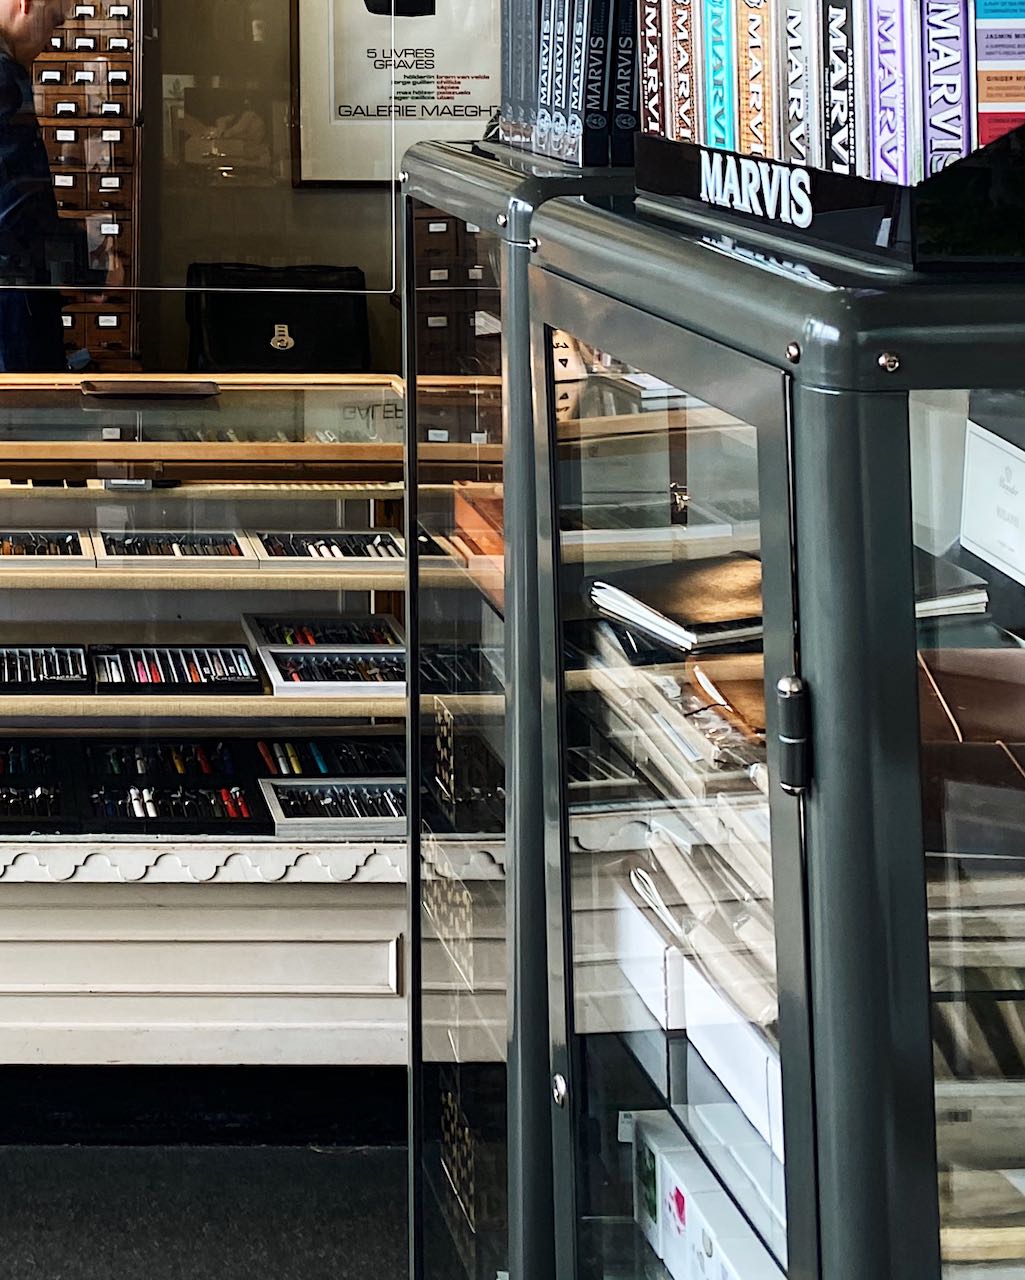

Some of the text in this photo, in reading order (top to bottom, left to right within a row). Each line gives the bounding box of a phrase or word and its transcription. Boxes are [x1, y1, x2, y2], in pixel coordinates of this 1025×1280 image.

[366, 48, 435, 59] 5 LIVRES
[373, 59, 435, 70] GRAVES
[539, 19, 551, 105] MARVIS
[554, 20, 565, 108] MARVIS
[571, 21, 584, 111] MARVIS
[586, 36, 605, 111] MARVIS
[615, 36, 634, 111] MARVIS
[643, 5, 659, 133] MARVI
[673, 9, 692, 142] MARVI
[711, 11, 725, 146] MARVI
[748, 13, 765, 156] MARVI
[787, 8, 806, 165] MARVI
[828, 5, 850, 176] MARVI
[877, 8, 899, 183] MARVI
[338, 105, 417, 117] GALERIE
[699, 150, 813, 229] MARVIS
